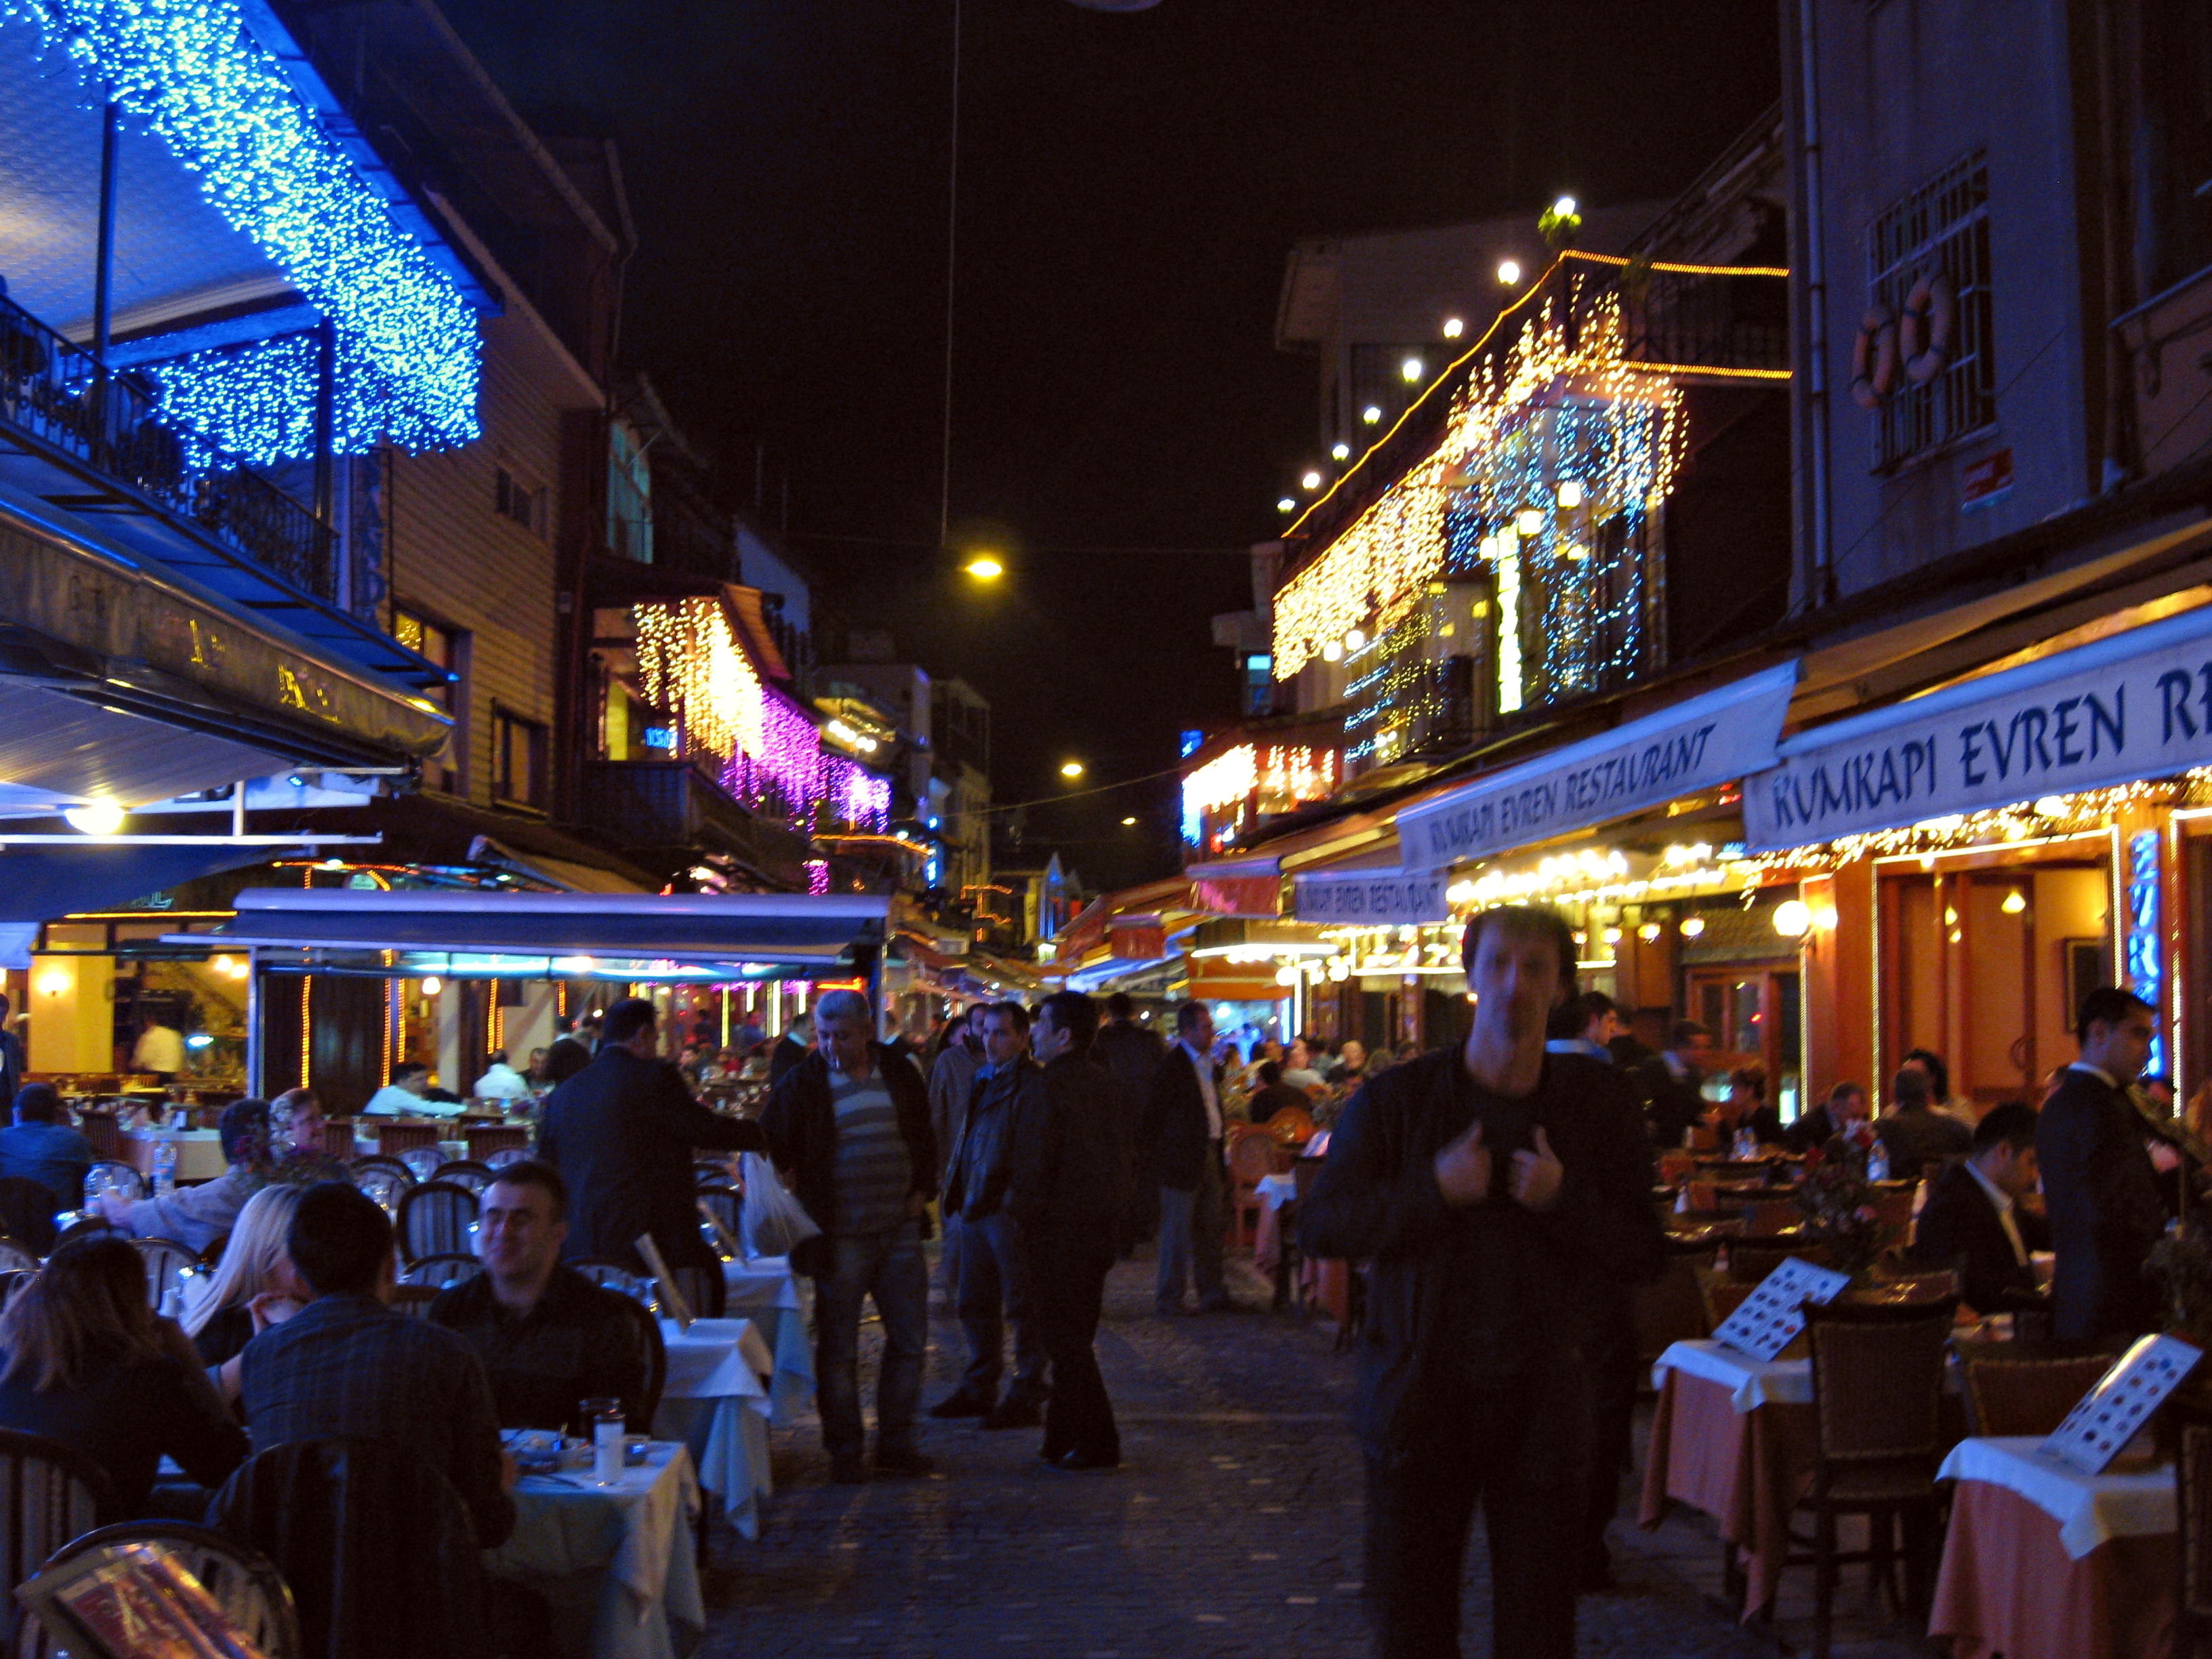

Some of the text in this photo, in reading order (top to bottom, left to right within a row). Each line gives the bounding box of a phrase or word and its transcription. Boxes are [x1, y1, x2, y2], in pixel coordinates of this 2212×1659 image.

[1501, 780, 1559, 833] EVREN
[1563, 723, 1717, 813] RESTAURANT
[1772, 733, 1938, 830] KUMKAPI
[1959, 682, 2126, 789] EVREN
